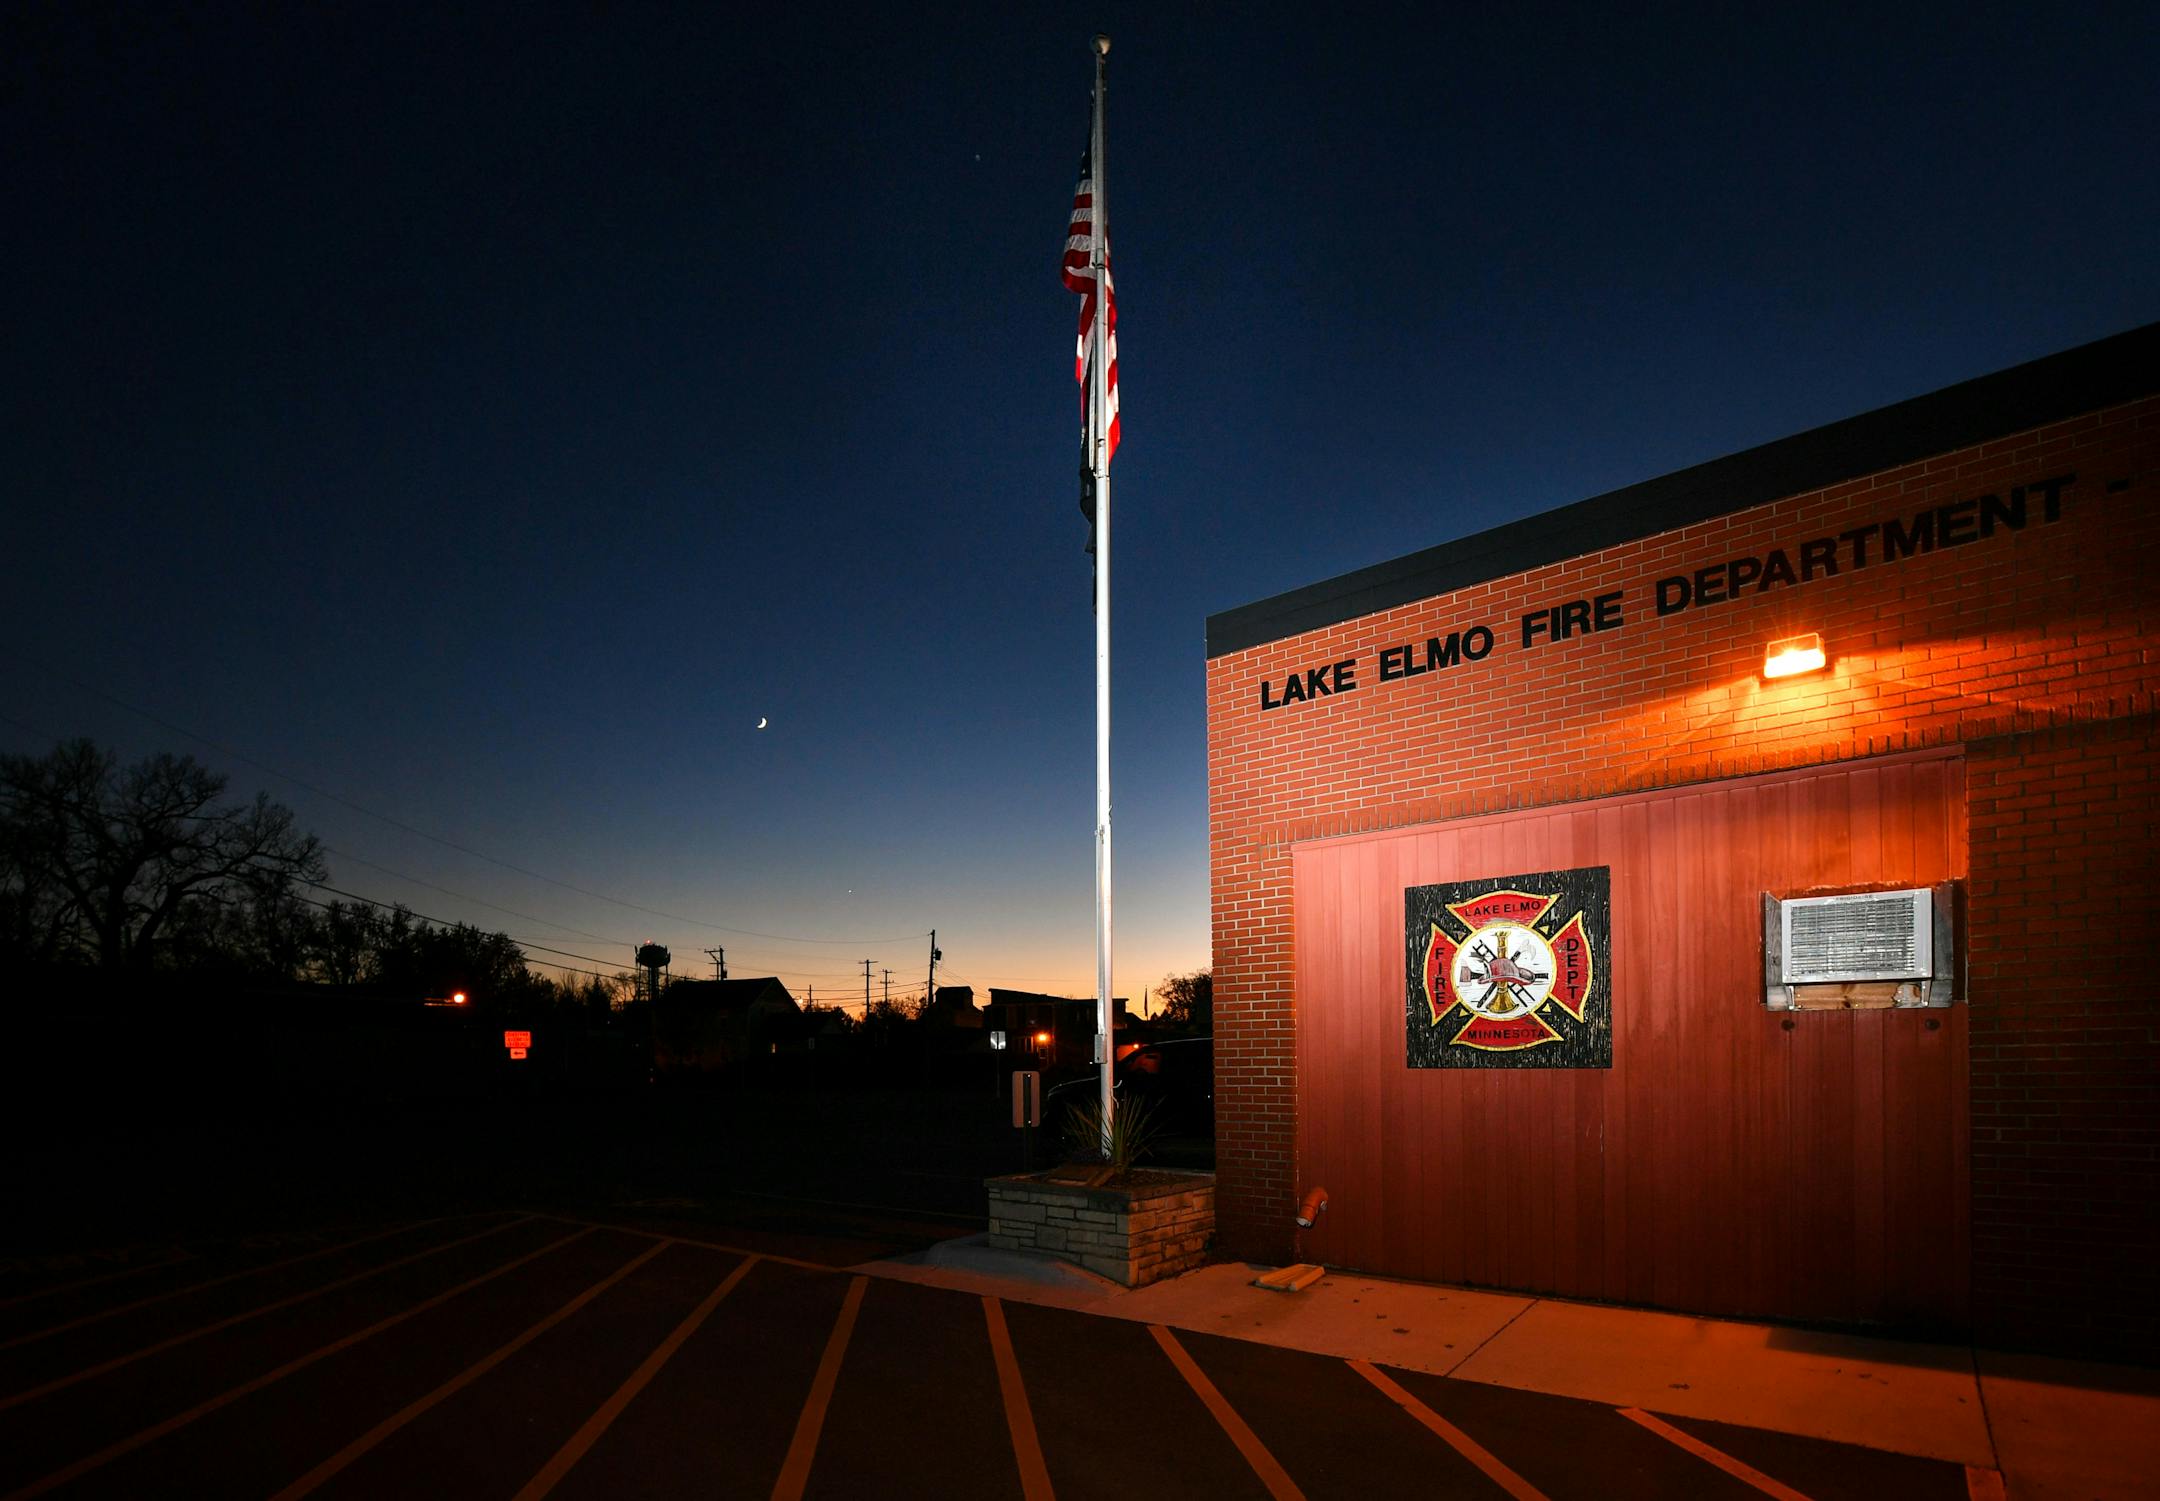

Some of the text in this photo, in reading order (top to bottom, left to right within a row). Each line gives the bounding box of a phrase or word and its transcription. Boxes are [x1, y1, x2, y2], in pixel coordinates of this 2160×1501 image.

[1261, 658, 1356, 711] LAKE
[1380, 625, 1494, 682] ELMO
[1522, 590, 1624, 649] FIRE
[1656, 473, 2078, 617] DEPARTMENT
[1465, 901, 1541, 917] LAKE ELMO
[1435, 947, 1447, 1005] FIRE
[1566, 938, 1580, 1000] DEPT
[1467, 1028, 1546, 1040] MINNESOTA
